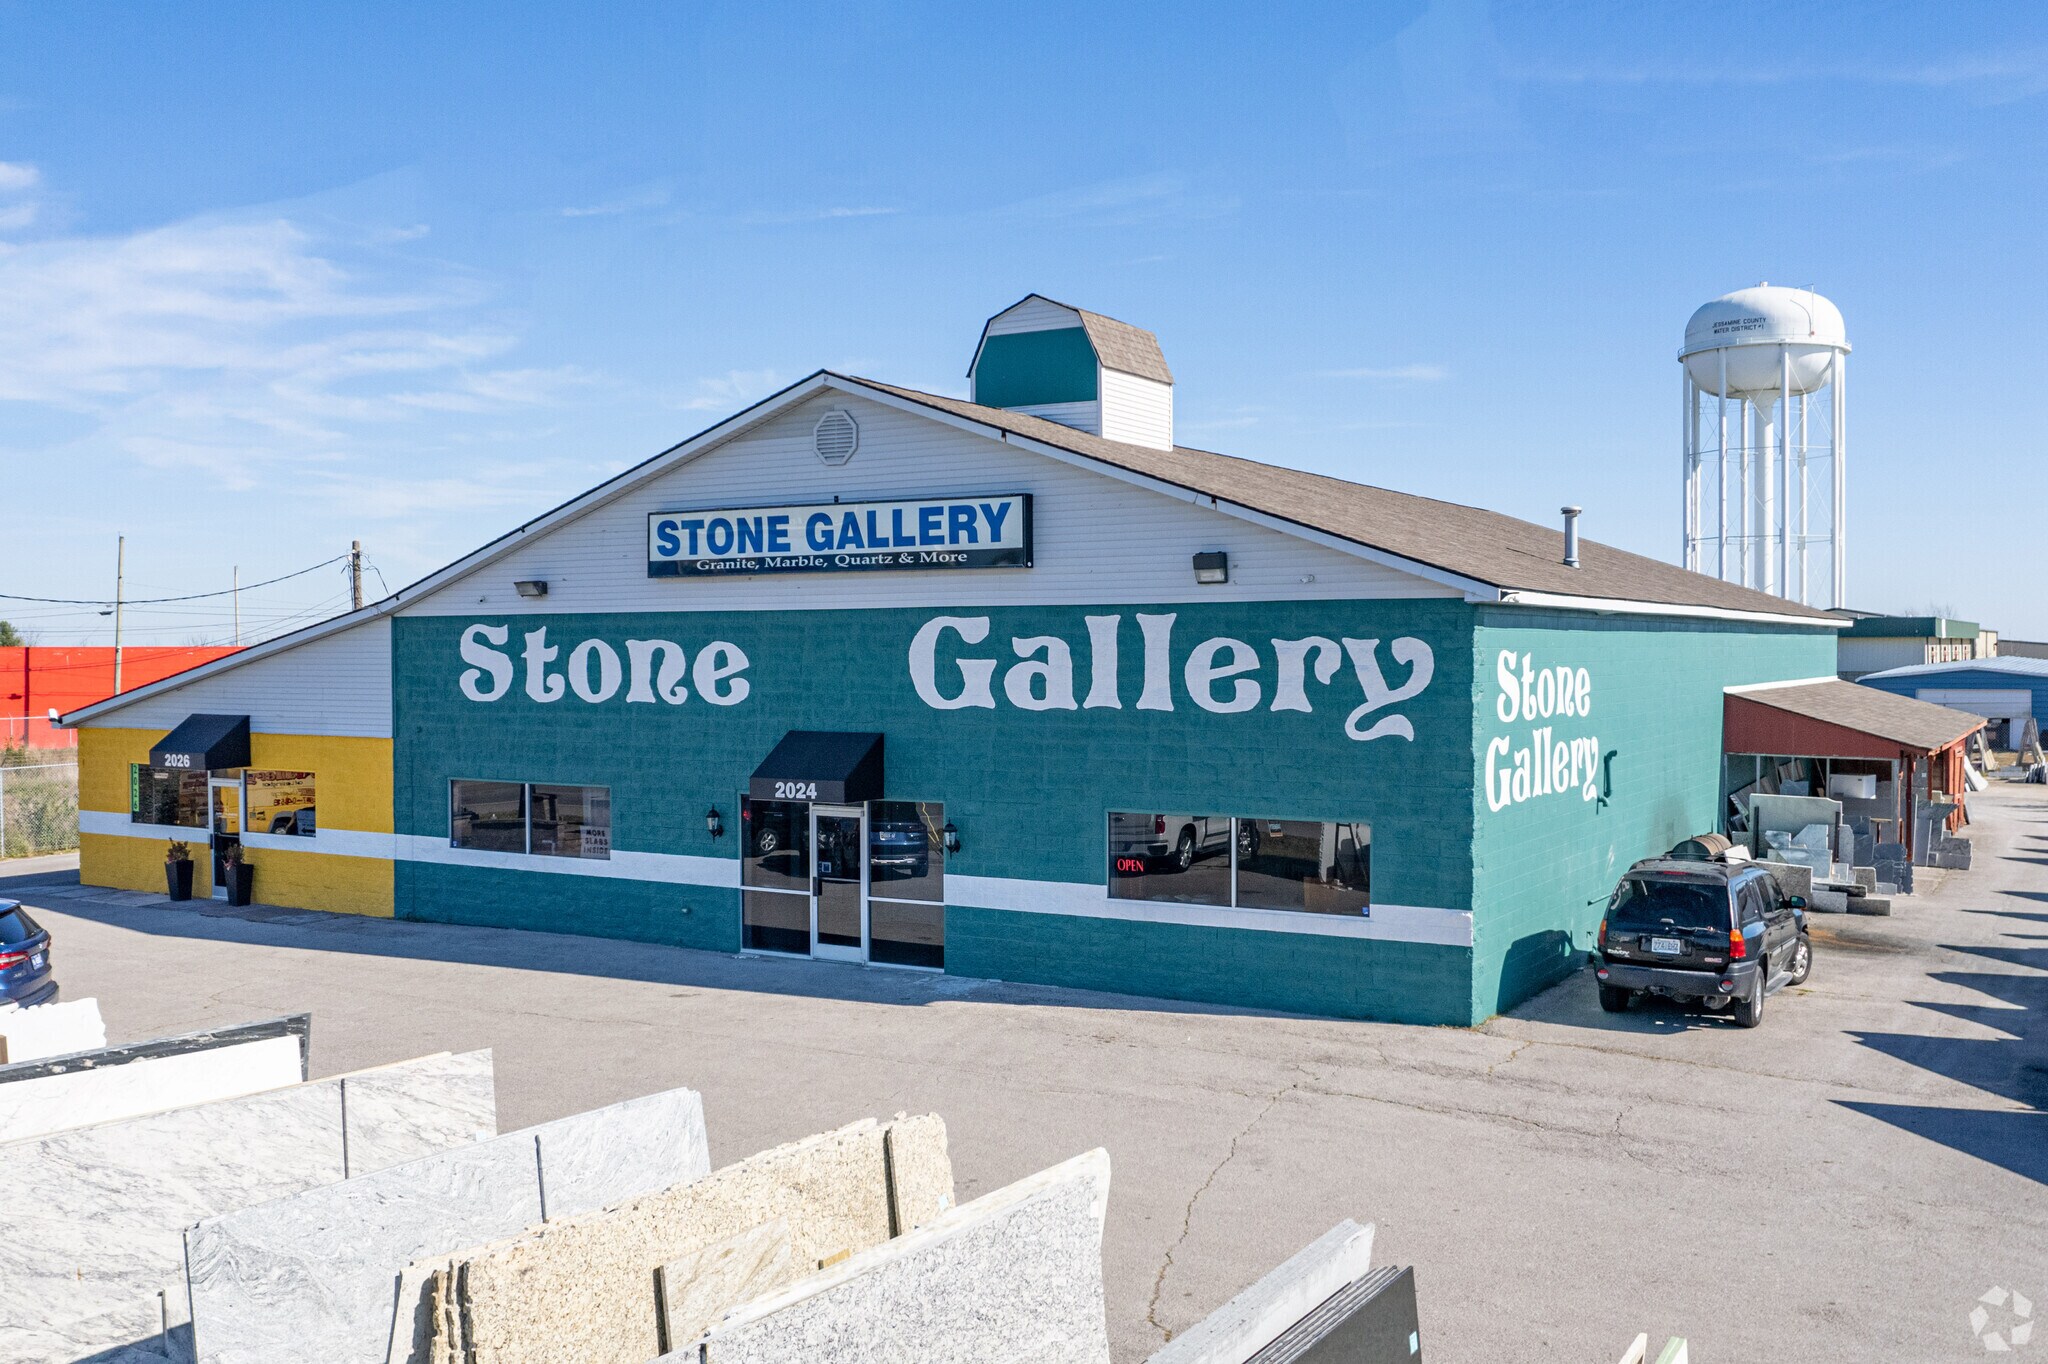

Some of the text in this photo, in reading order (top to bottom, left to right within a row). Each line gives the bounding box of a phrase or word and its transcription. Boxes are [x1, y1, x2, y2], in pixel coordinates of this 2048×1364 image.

[1712, 317, 1766, 328] JESSAMINE COUNTY
[1731, 324, 1757, 332] DISTRICT
[656, 502, 1012, 557] STONE GALLERY
[696, 551, 968, 570] Granite, Marble, Quartz & More
[459, 612, 1434, 742] Stone Gallery
[1496, 649, 1591, 723] Stone
[164, 753, 190, 768] 2026
[1485, 726, 1599, 813] Gallery
[774, 781, 818, 800] 2024
[586, 829, 606, 837] MORE
[585, 837, 608, 845] SLABS
[583, 846, 608, 854] INSIDE
[1117, 858, 1144, 872] OPEN
